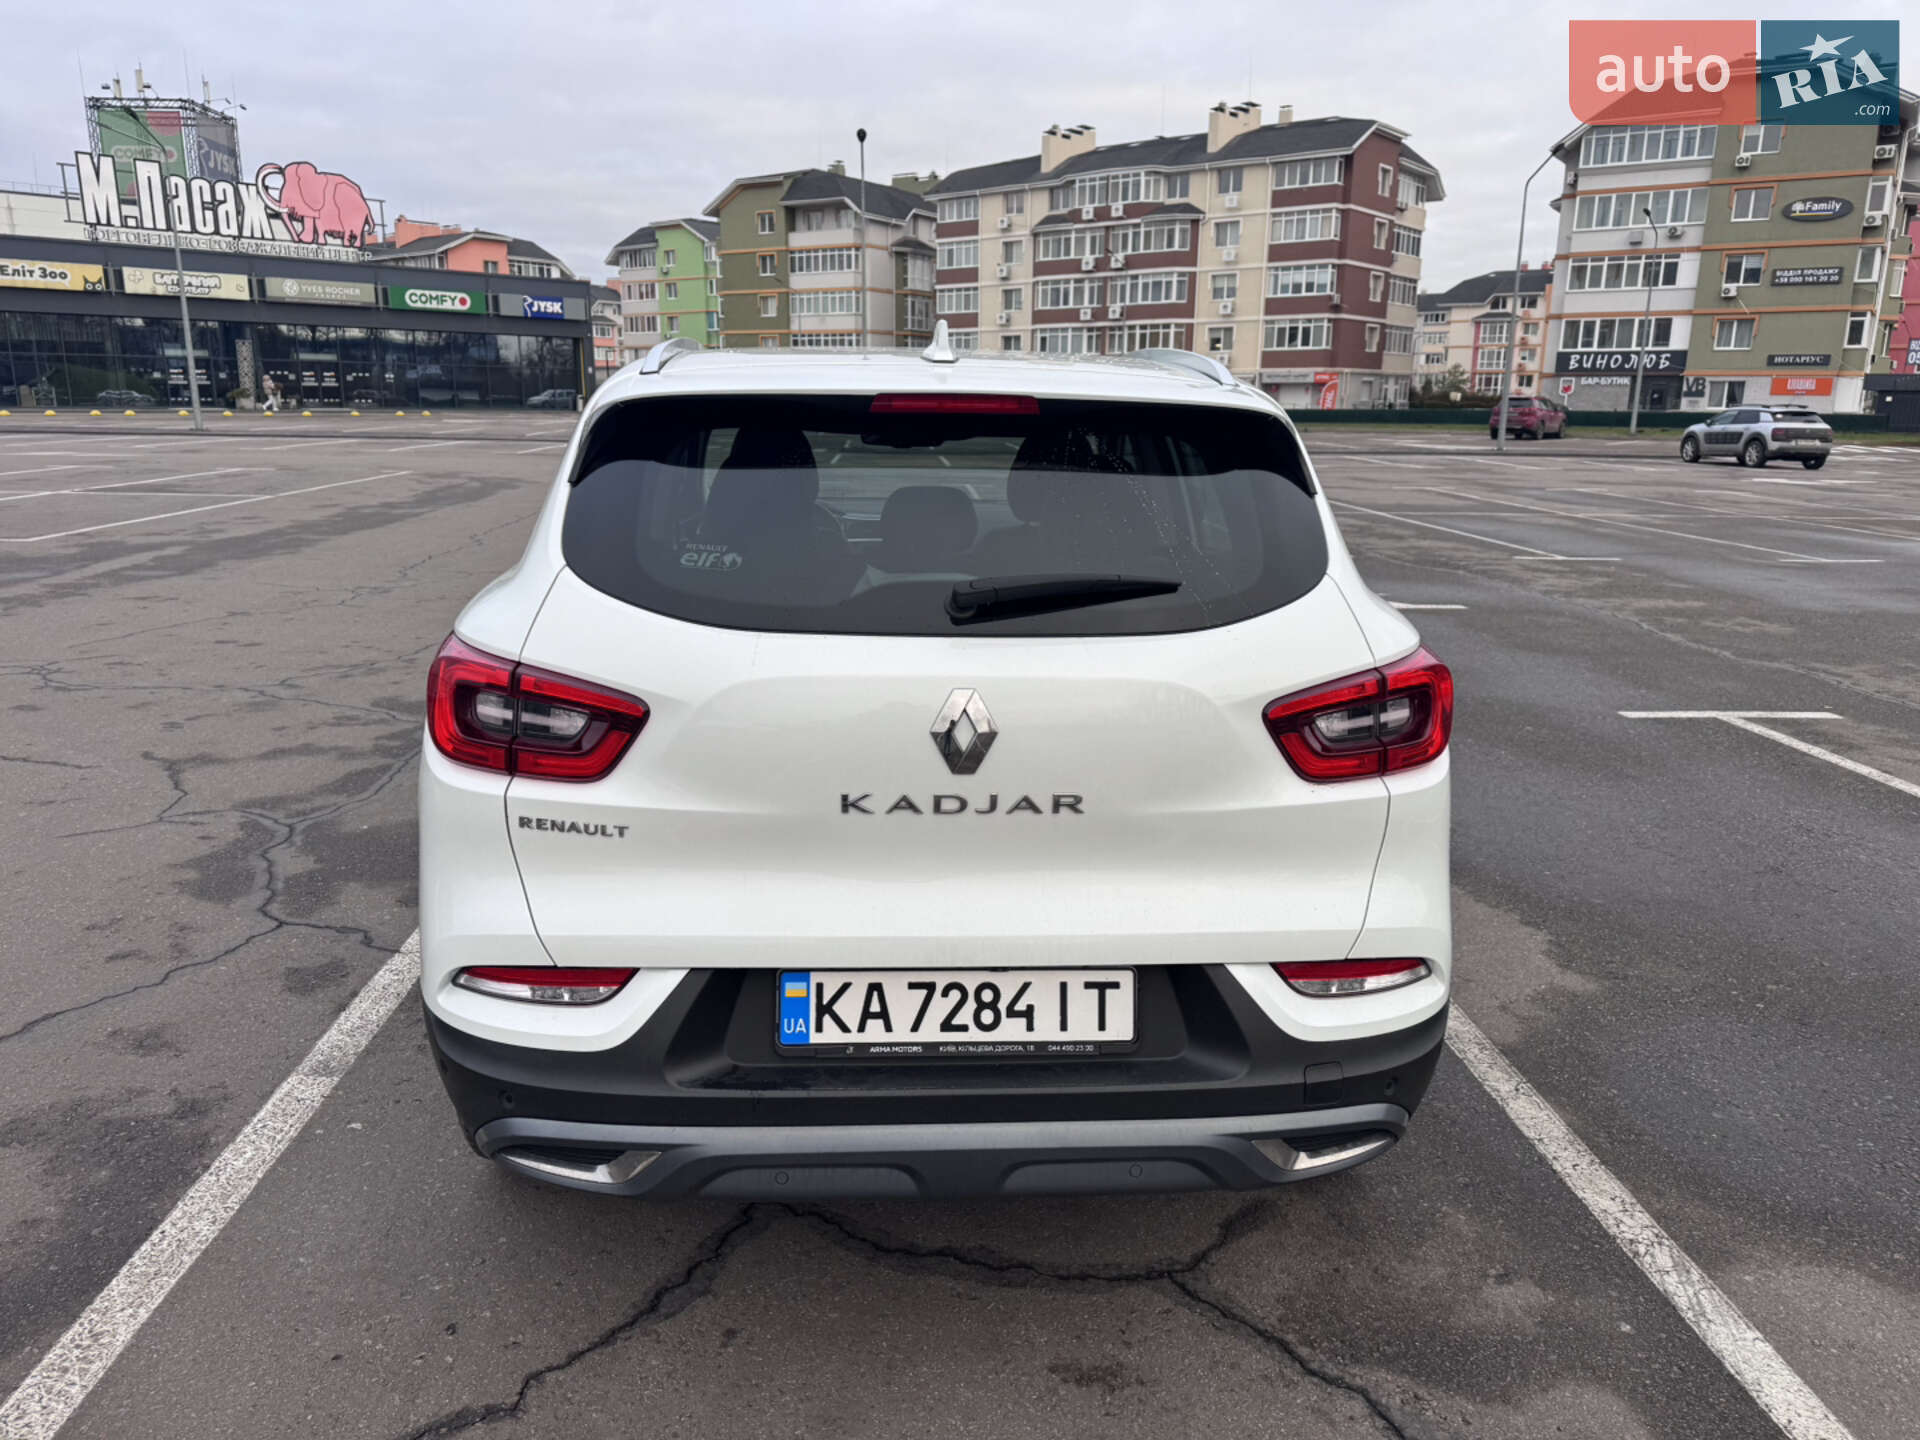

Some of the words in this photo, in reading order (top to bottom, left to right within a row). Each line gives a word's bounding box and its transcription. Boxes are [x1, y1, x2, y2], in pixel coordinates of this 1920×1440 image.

[113, 148, 165, 160] COMFY
[208, 149, 237, 177] JYSK
[75, 151, 274, 240] М.Пасаж
[1805, 200, 1842, 213] Family
[0, 264, 36, 279] Еліт
[38, 265, 68, 280] Зоо
[301, 284, 324, 293] YVES
[325, 286, 361, 296] ROCHER
[408, 292, 457, 306] COMFY
[532, 301, 562, 314] JYSK
[1568, 353, 1671, 370] ВИНОЛЮБ
[1774, 355, 1825, 363] НОТАРІУС
[1580, 376, 1632, 385] БАР-БУТИК
[680, 551, 720, 567] elf
[840, 794, 1084, 815] KADJAR
[518, 816, 629, 839] RENAULT
[814, 981, 894, 1033] KA
[907, 981, 1035, 1033] 7284
[1059, 981, 1121, 1032] IT
[783, 1018, 807, 1034] UA
